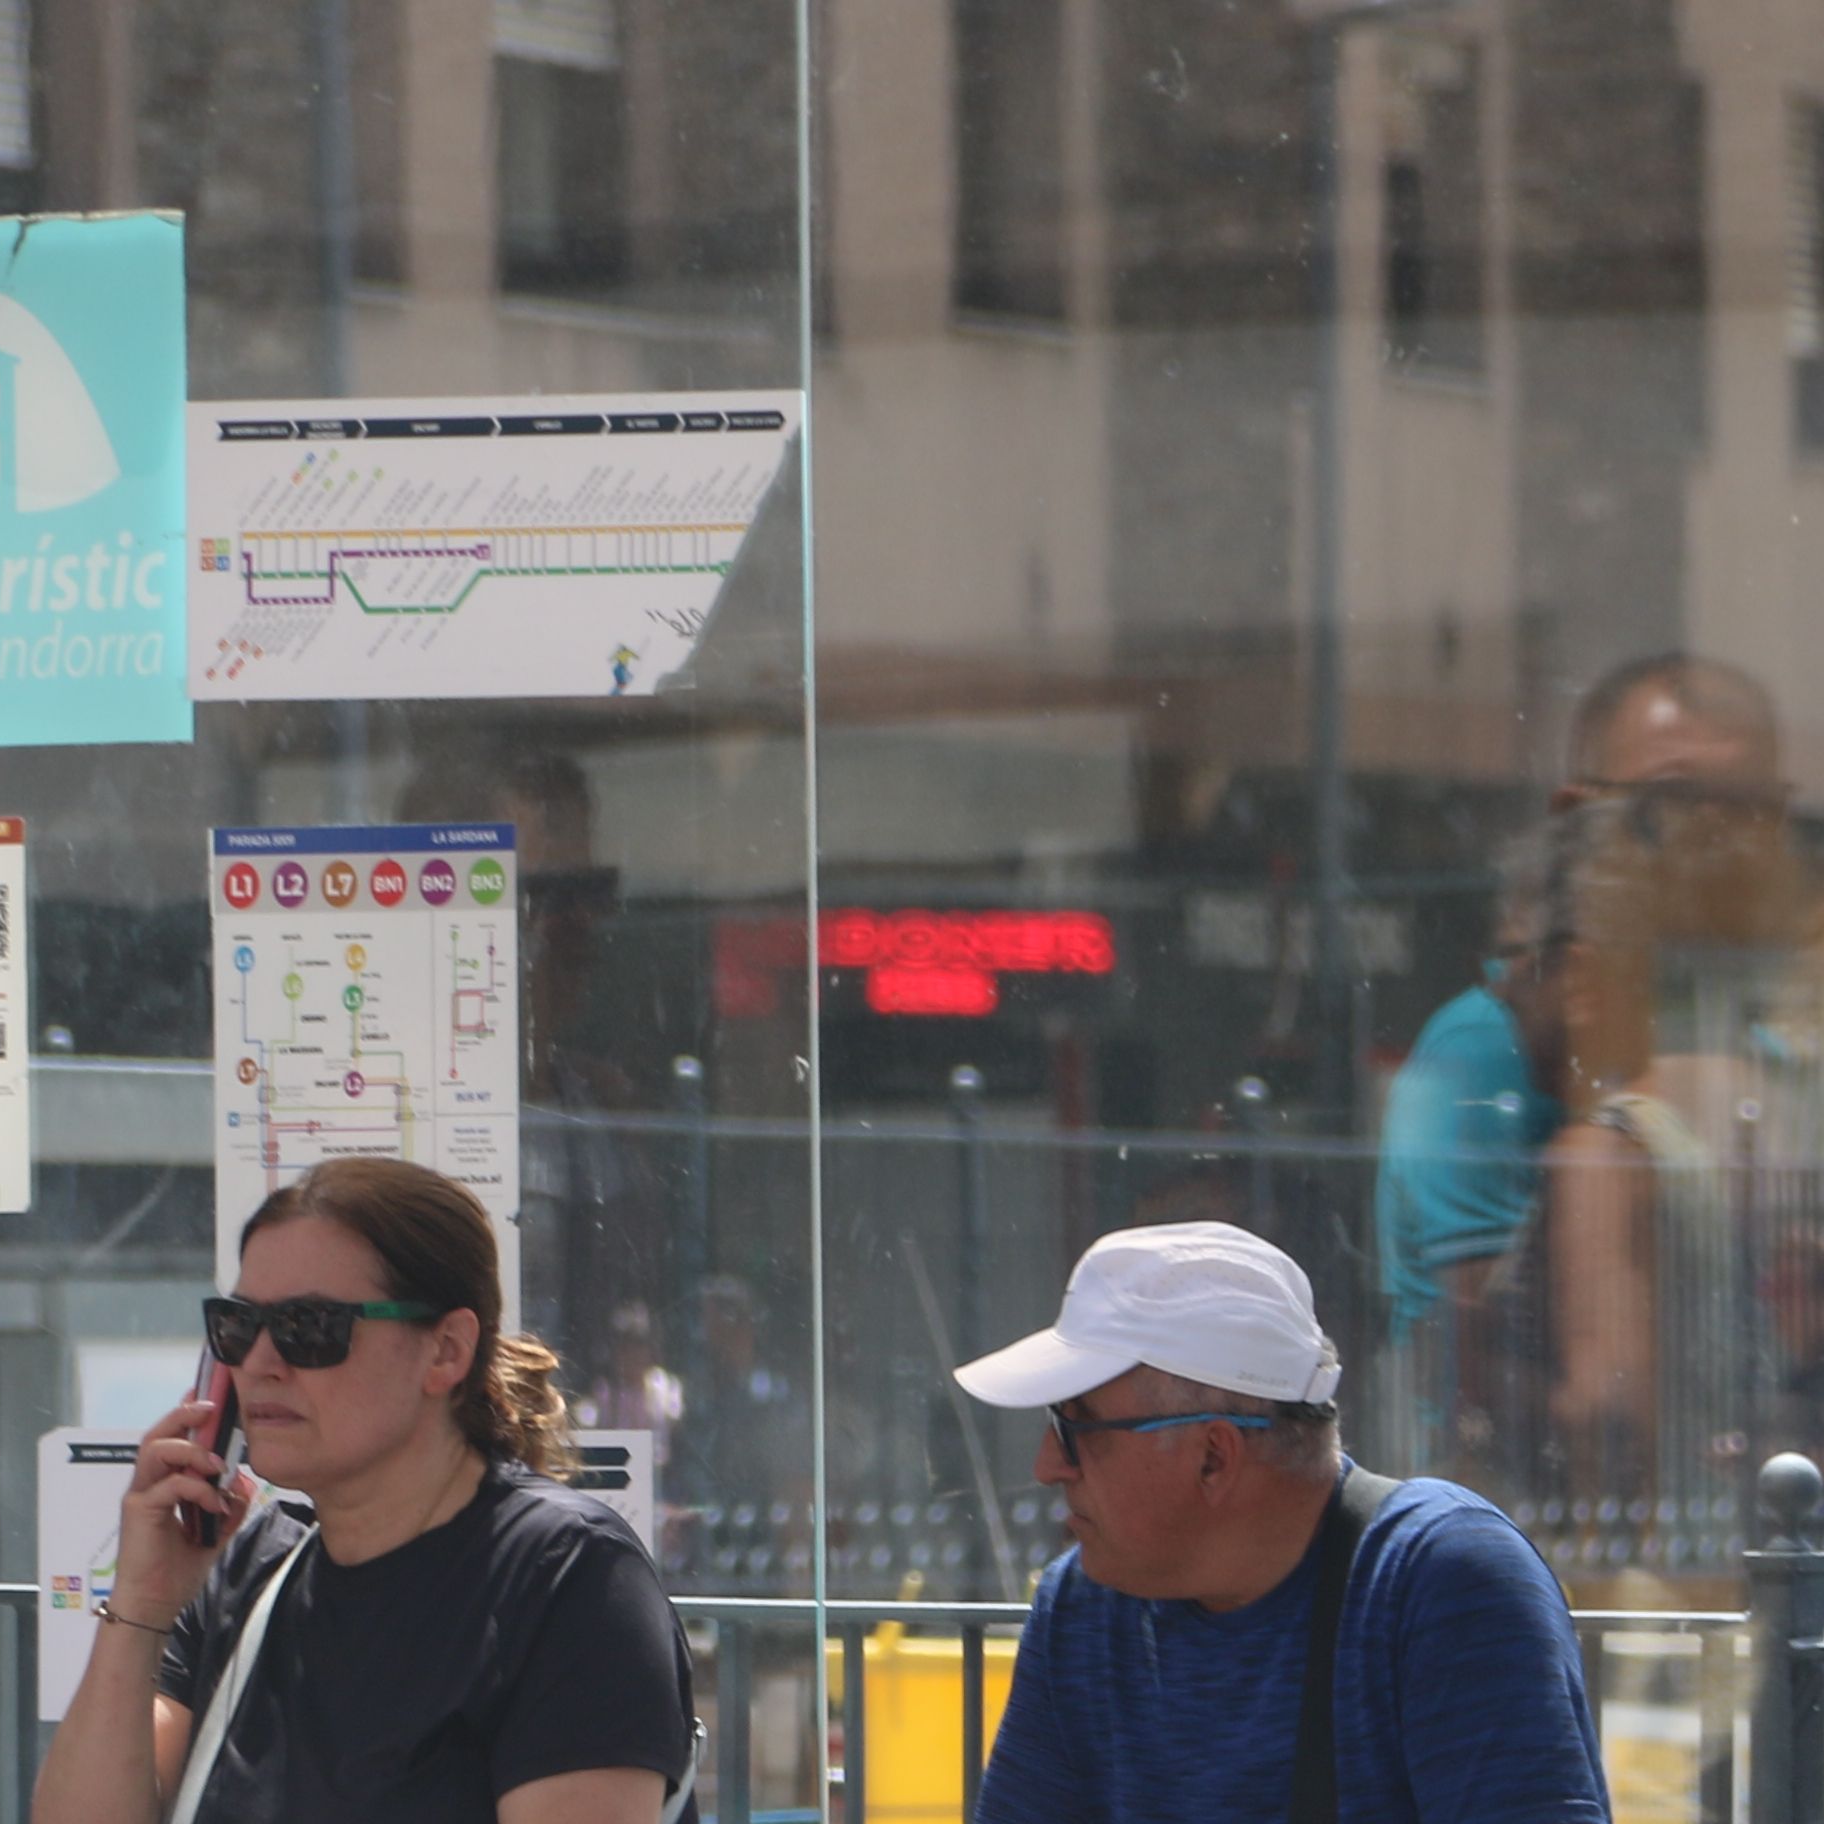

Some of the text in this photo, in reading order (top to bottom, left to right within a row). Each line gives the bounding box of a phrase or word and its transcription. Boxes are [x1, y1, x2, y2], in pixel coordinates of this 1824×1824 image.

[229, 871, 505, 898] L1 L2 L7 BN1 BN2 BN3
